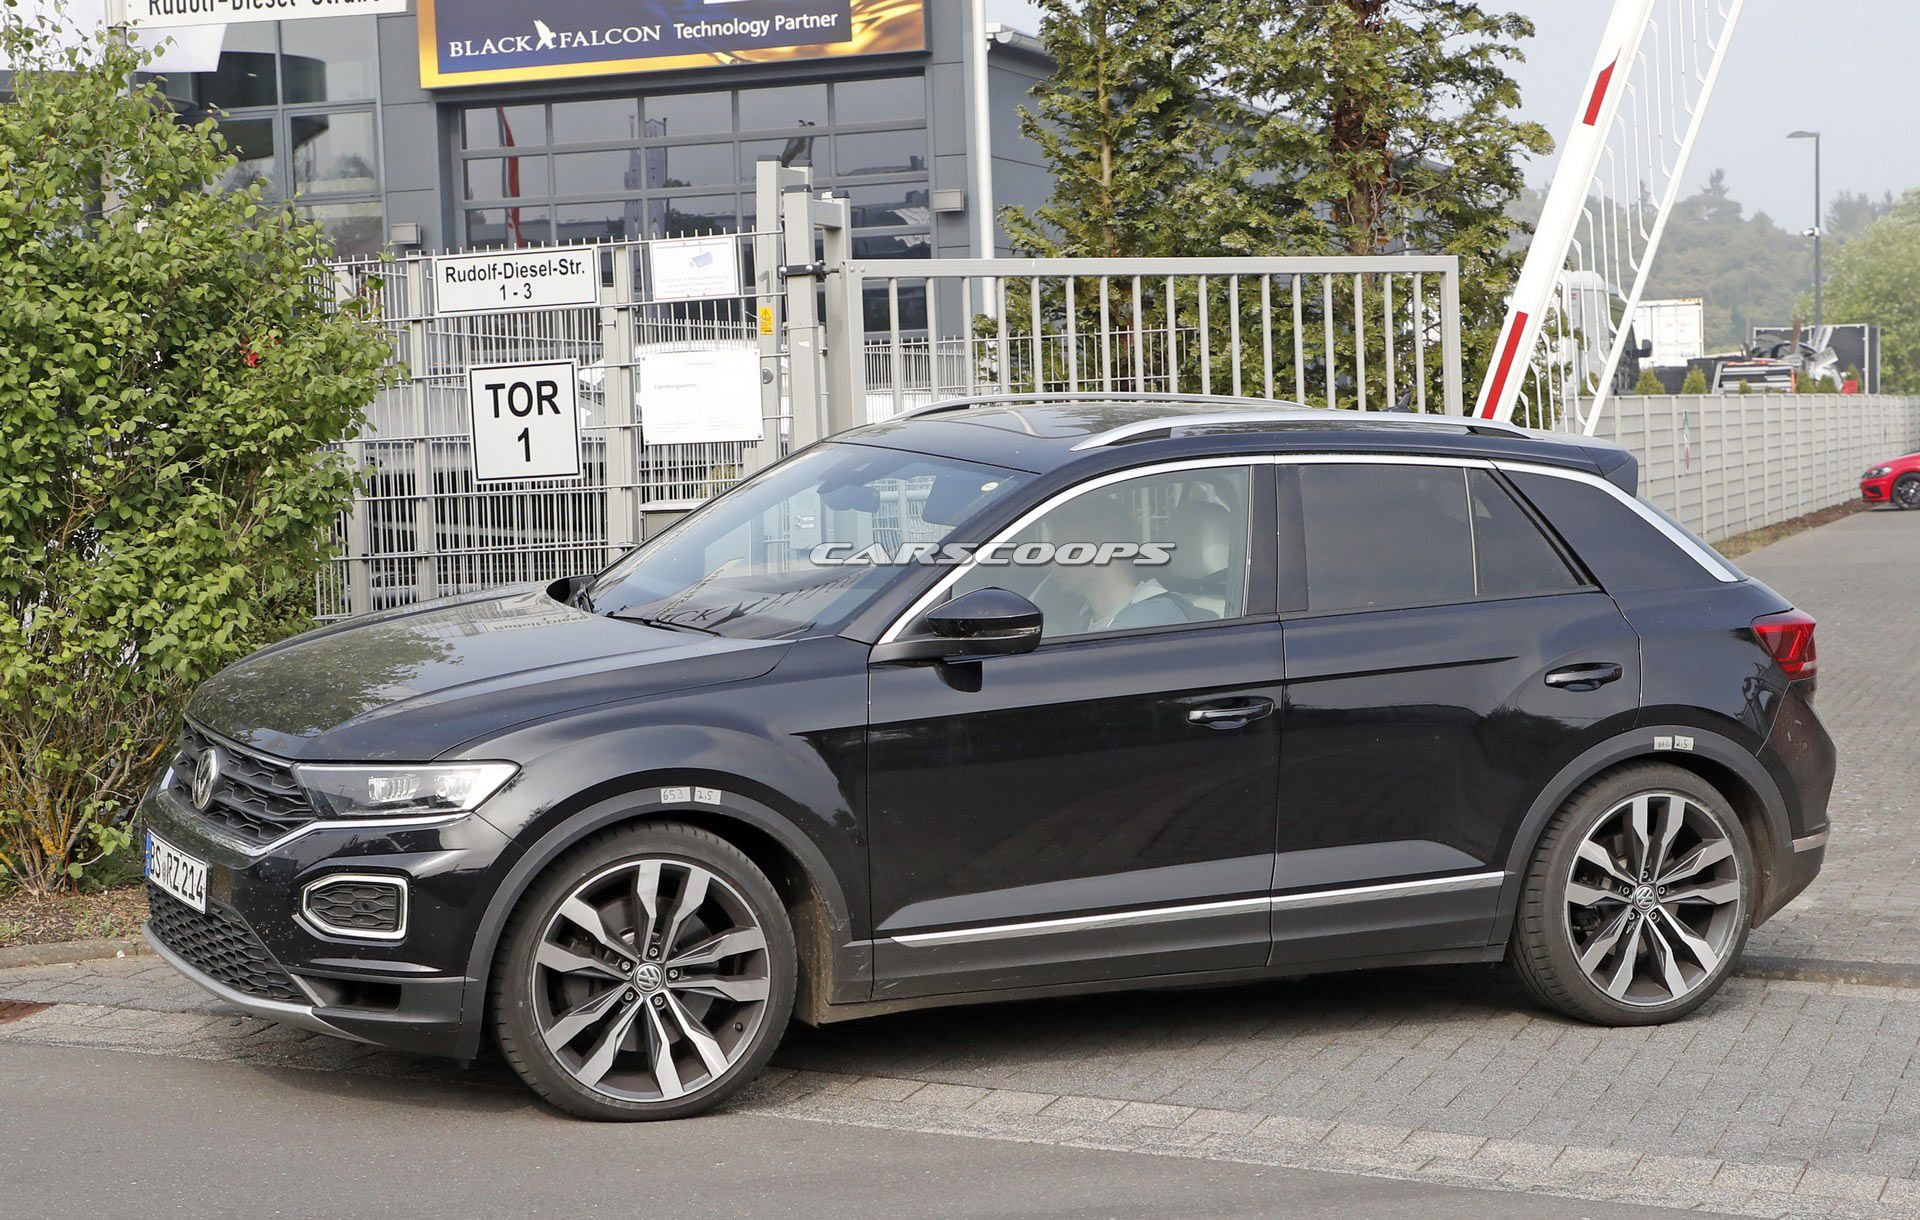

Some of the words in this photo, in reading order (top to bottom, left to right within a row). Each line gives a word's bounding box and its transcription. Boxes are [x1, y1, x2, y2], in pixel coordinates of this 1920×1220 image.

[148, 0, 297, 16] Rudol-es
[449, 36, 533, 58] BLACK
[559, 25, 662, 49] FALCON
[673, 18, 770, 40] Technology
[775, 13, 838, 31] Partner
[445, 258, 585, 283] Rudolf-Diesel-Str.
[499, 284, 506, 300] 1
[523, 282, 532, 299] 3
[484, 380, 561, 418] TOR
[517, 427, 531, 462] 1
[167, 851, 180, 892] RZ
[181, 861, 203, 905] 214
